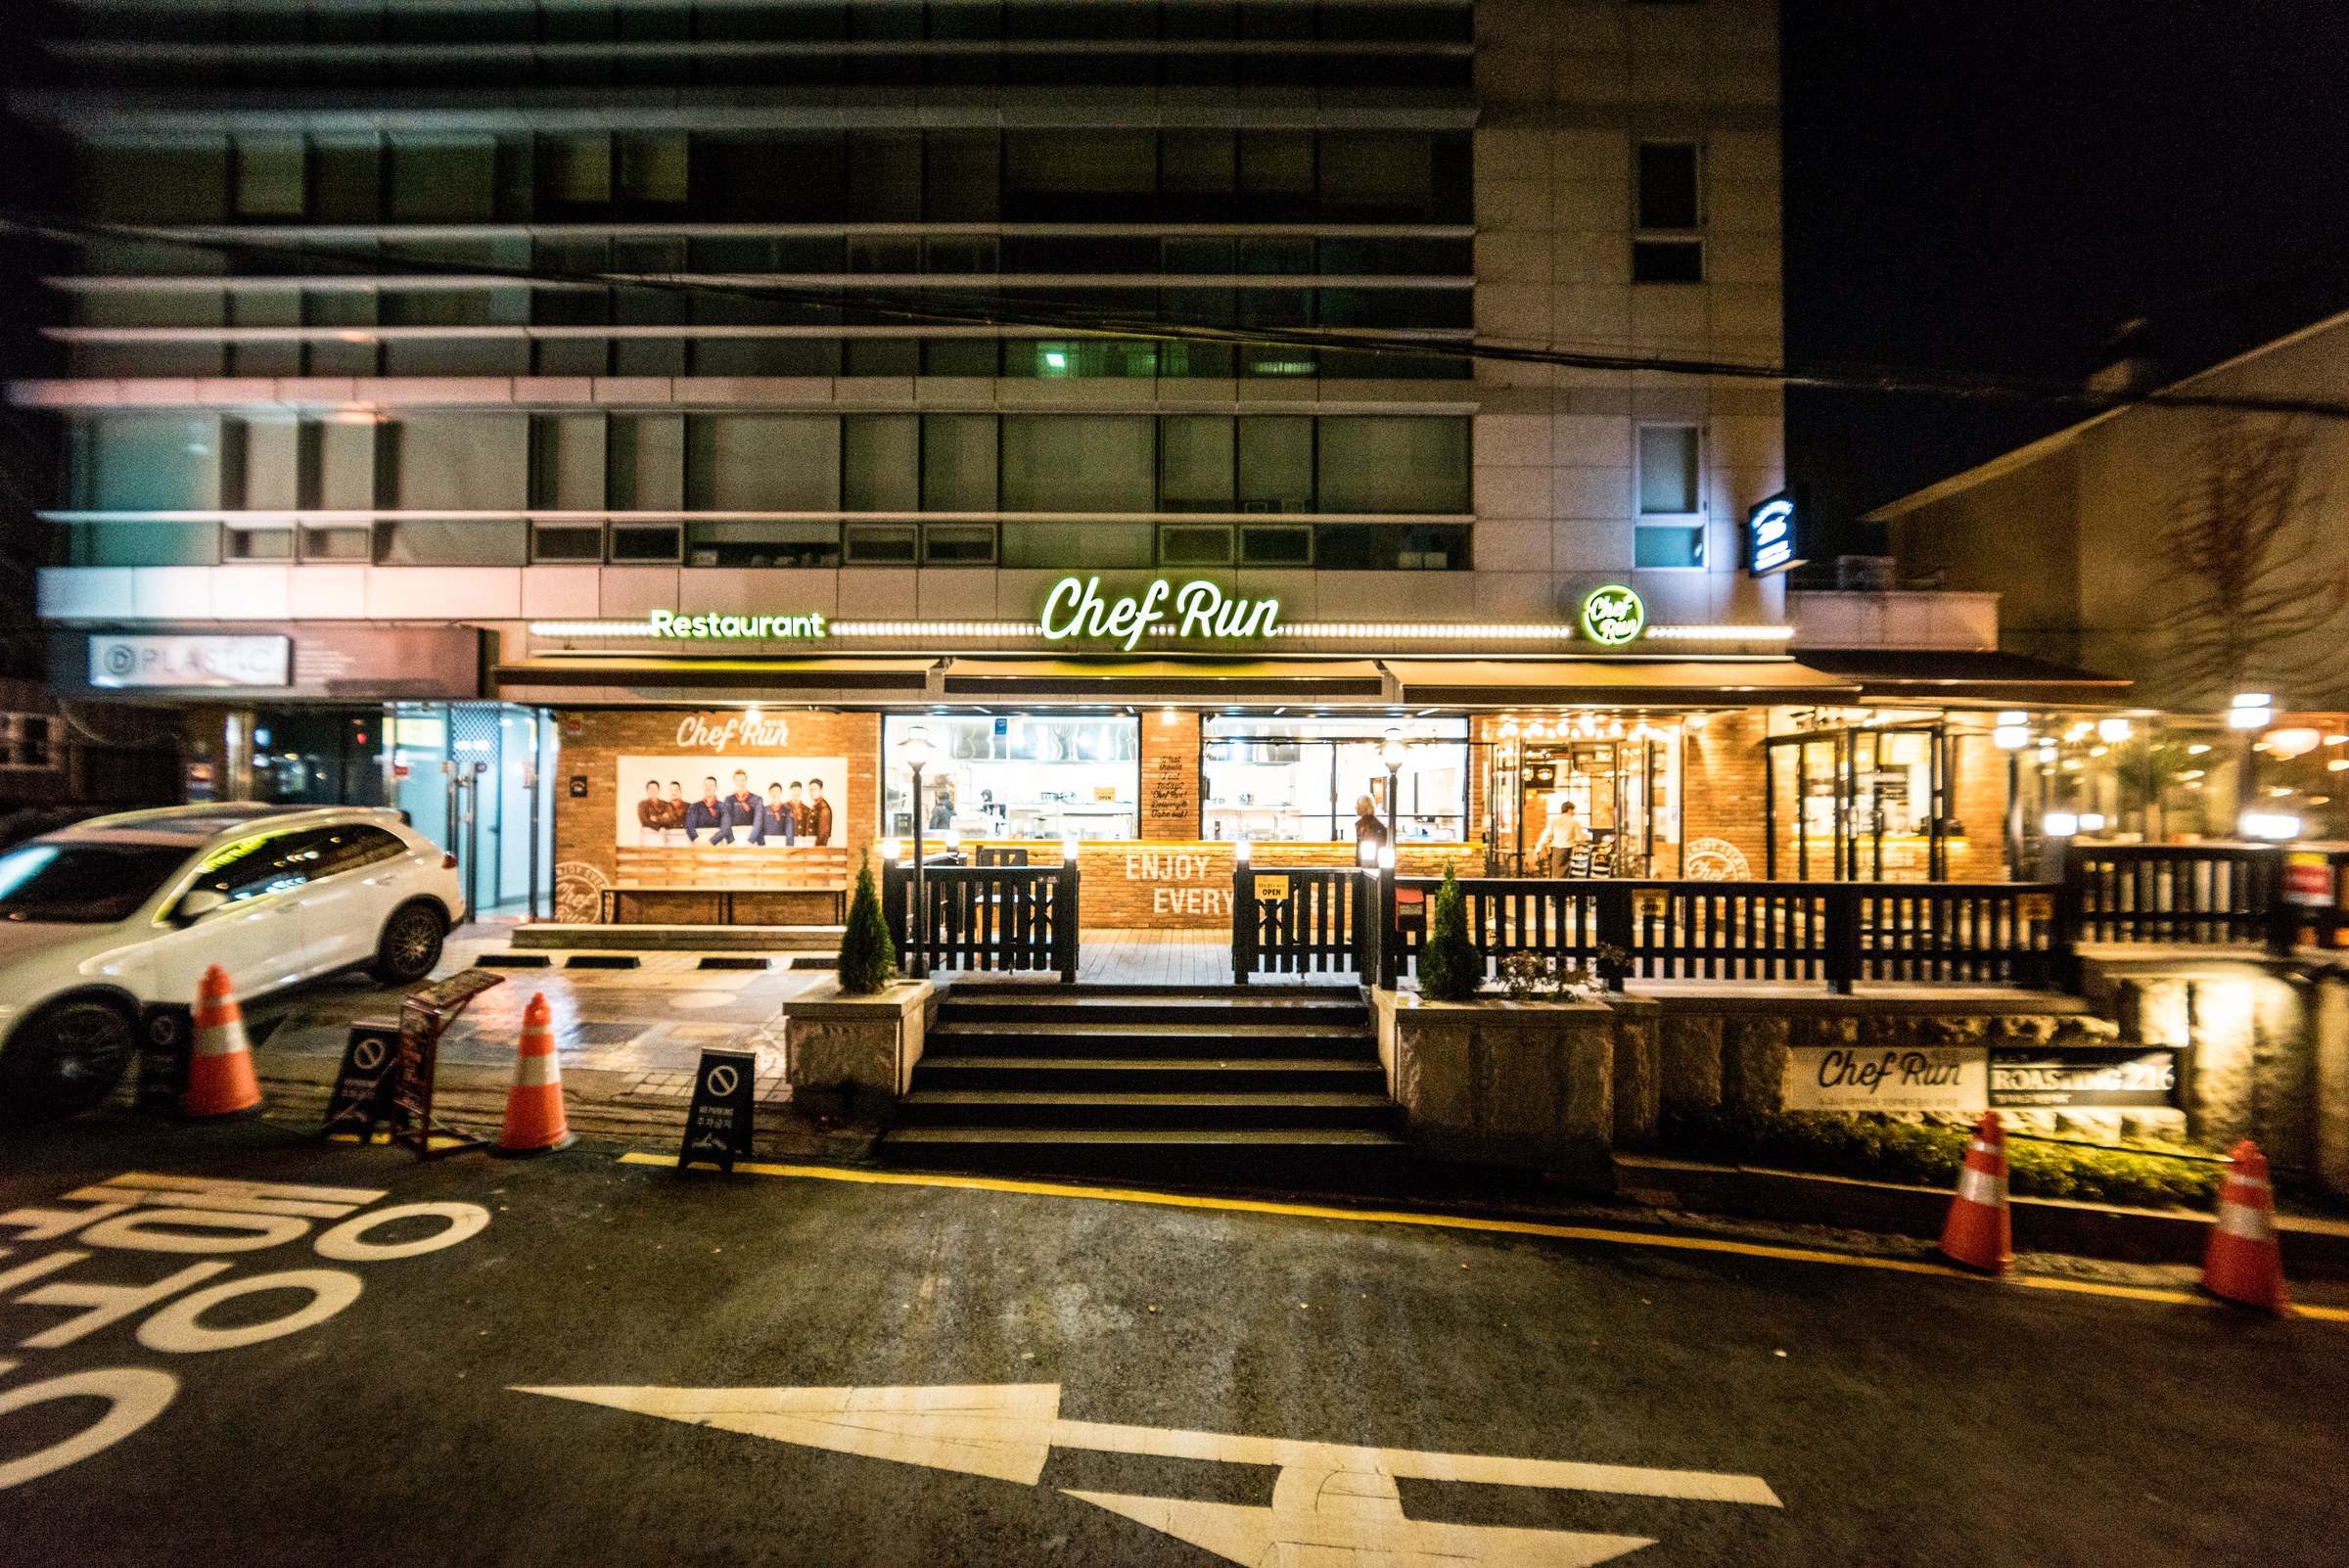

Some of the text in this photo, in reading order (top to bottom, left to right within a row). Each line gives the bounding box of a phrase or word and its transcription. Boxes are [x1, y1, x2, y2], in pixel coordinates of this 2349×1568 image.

[651, 608, 826, 638] Restaurant
[1041, 576, 1279, 652] Chef Run
[1589, 594, 1635, 622] Chef
[1598, 618, 1637, 640] Run
[676, 715, 789, 753] Chef Run
[1125, 854, 1211, 880] ENJOY
[1819, 1050, 1962, 1095] Chef Run
